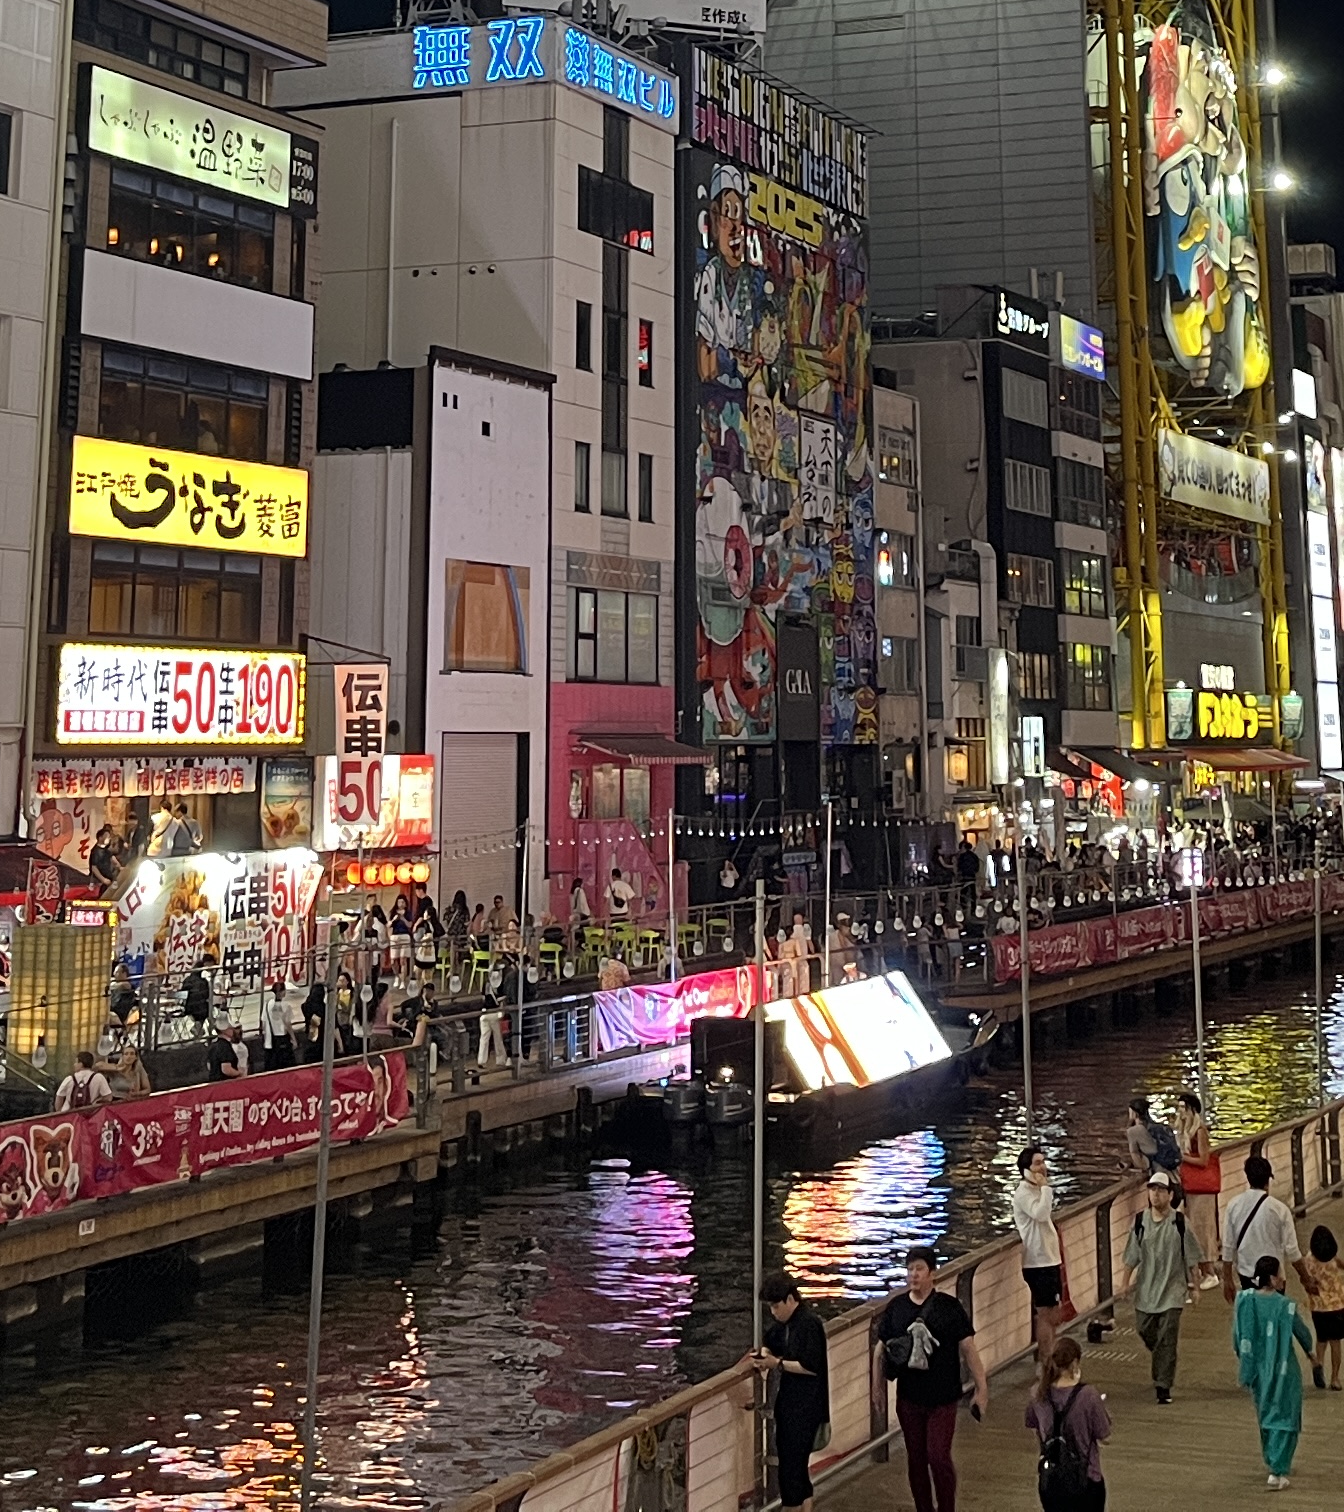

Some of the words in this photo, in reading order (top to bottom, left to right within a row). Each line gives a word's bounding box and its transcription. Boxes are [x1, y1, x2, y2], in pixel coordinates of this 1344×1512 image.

[412, 15, 545, 89] 無双
[189, 118, 267, 187] 温野菜
[748, 172, 824, 247] 2025
[110, 458, 249, 539] うなぎ
[74, 656, 148, 704] 新時代
[152, 660, 171, 733] 伝串
[172, 661, 216, 734] 50
[218, 662, 235, 733] 生中
[236, 664, 294, 734] 190
[342, 673, 383, 757] 伝串
